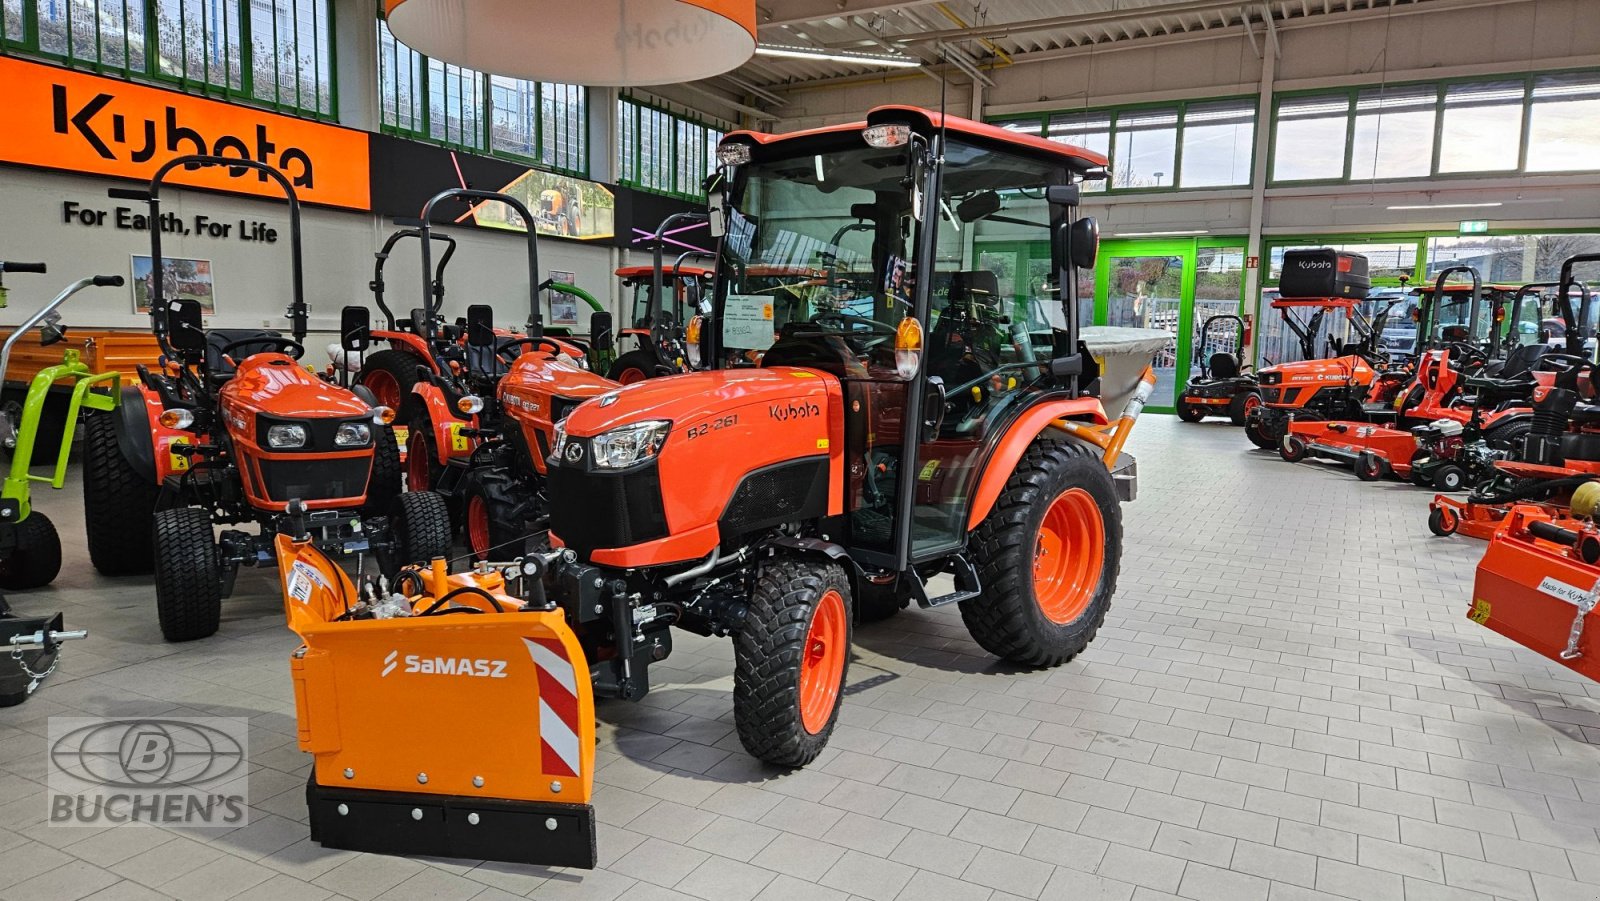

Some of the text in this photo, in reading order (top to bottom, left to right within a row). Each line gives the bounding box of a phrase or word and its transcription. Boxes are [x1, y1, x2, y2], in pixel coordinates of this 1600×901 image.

[52, 83, 314, 189] Kubota
[63, 201, 278, 243] For Eath, For Life
[1298, 260, 1332, 269] Kubota
[768, 401, 820, 422] Kubota
[686, 414, 739, 441] B2-261
[404, 655, 508, 678] SaMASZ
